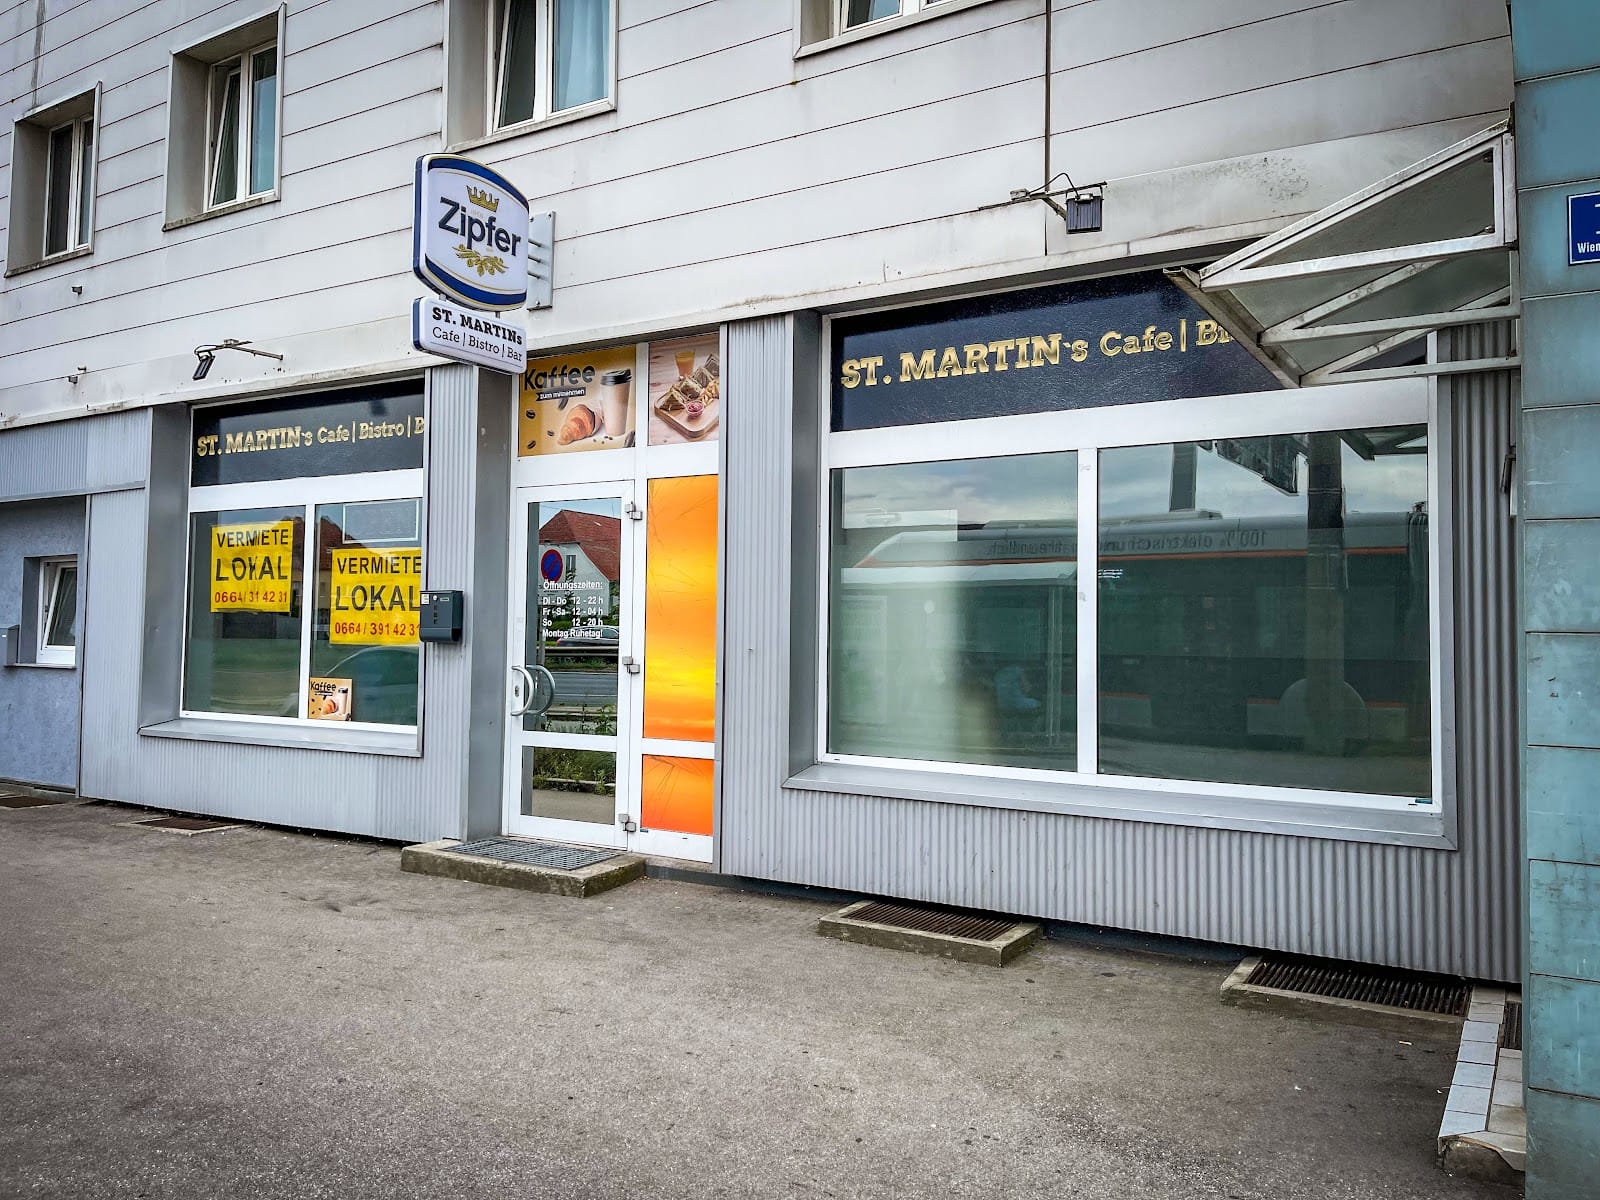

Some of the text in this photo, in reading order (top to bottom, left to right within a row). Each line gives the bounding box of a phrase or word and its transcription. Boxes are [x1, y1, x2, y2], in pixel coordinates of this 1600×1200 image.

[438, 196, 521, 257] Zipfer
[432, 306, 523, 346] ST. MARTINs
[432, 326, 460, 343] Cafe
[468, 334, 500, 354] Bistro
[507, 346, 522, 362] Bar
[841, 355, 892, 389] ST.
[1100, 324, 1174, 357] Cafe
[524, 365, 596, 390] Kaffee
[197, 435, 221, 457] ST.
[317, 425, 349, 444] Cafe
[359, 421, 404, 440] Bistro
[216, 529, 289, 548] VERMIETE
[336, 555, 421, 574] VERMIETE
[543, 579, 603, 590] Öffnungszeiten:
[335, 584, 420, 611] LOKAL
[542, 597, 551, 605] Di
[556, 597, 567, 605] Do
[572, 597, 580, 605] 12
[587, 596, 597, 605] 22
[542, 608, 550, 616] Fr
[572, 607, 580, 616] 12
[587, 607, 597, 616] 04
[542, 618, 552, 627] So
[572, 618, 580, 627] 12
[587, 618, 597, 627] 20
[542, 628, 603, 638] Montag Ruhetag!
[310, 681, 337, 691] Kaffee
